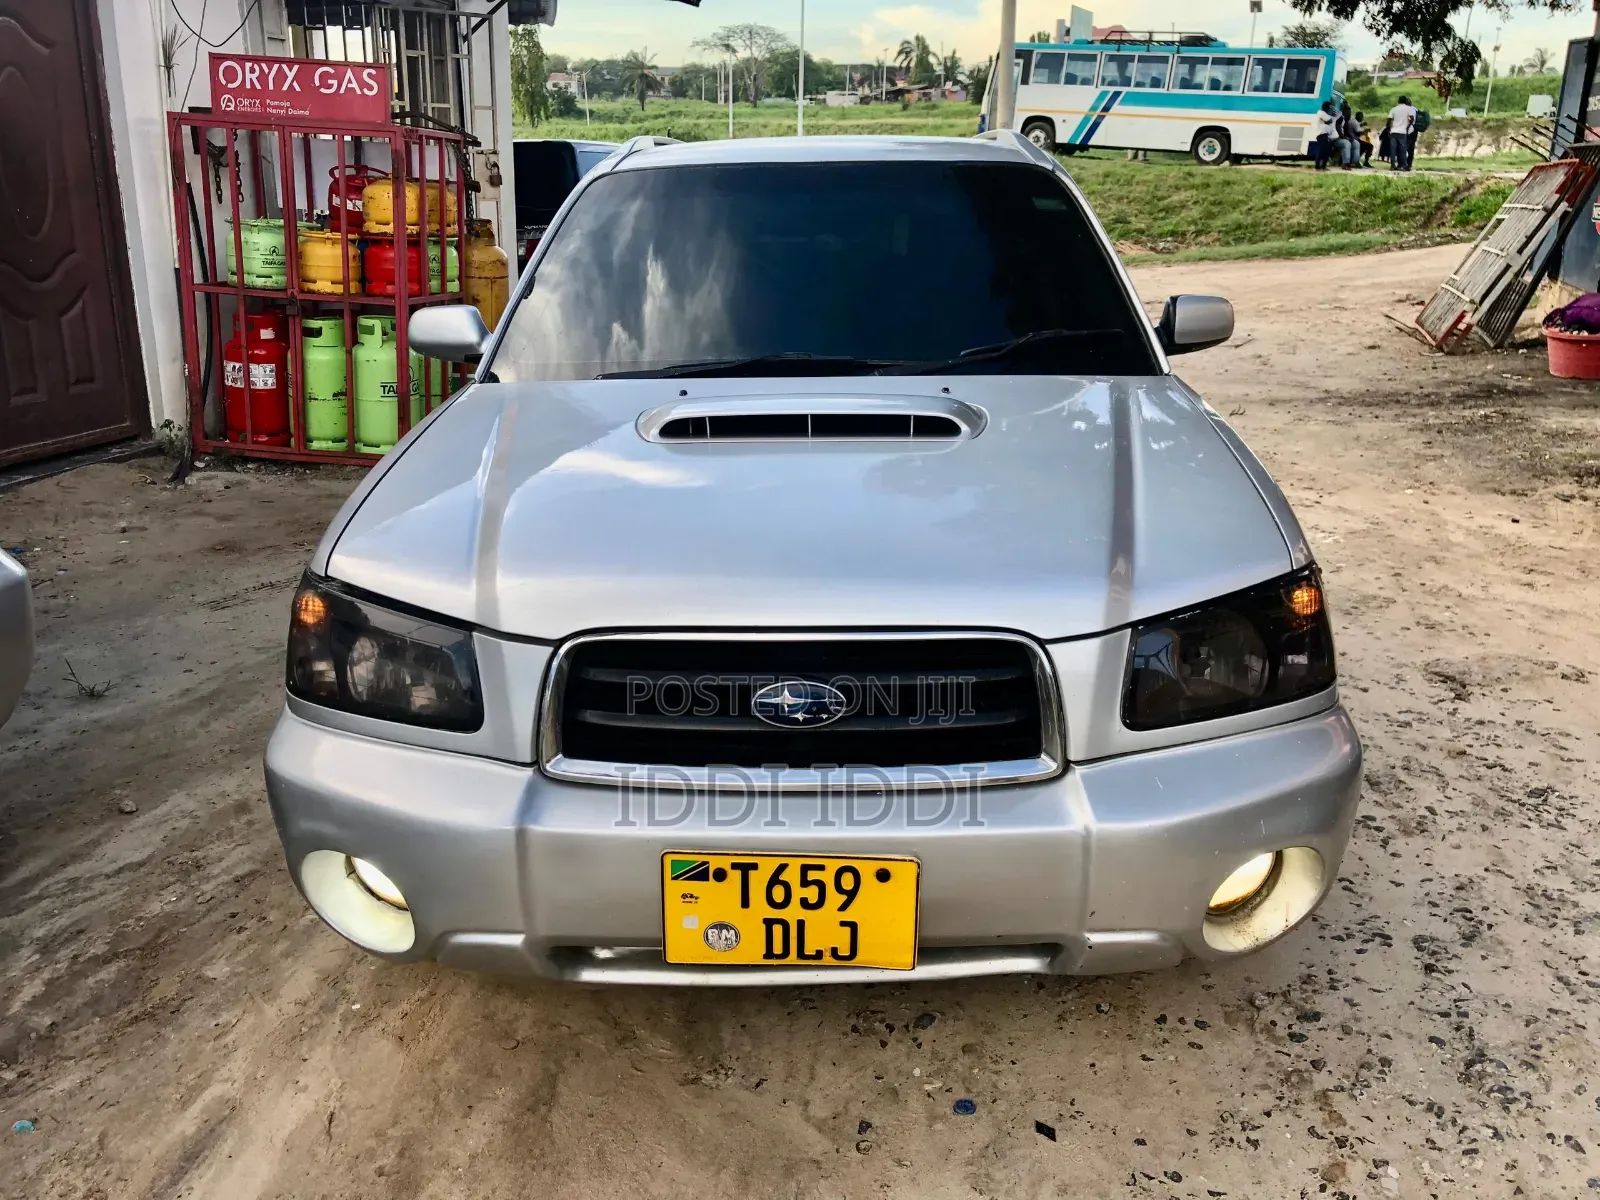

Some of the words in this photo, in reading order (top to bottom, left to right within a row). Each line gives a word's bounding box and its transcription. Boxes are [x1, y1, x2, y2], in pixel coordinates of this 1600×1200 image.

[218, 60, 302, 92] ORYX
[314, 66, 379, 96] GAS
[236, 97, 262, 108] ORYX
[266, 99, 291, 108] Pamoja
[288, 108, 310, 116] Daima
[730, 861, 862, 913] T659
[762, 917, 859, 962] DLJ
